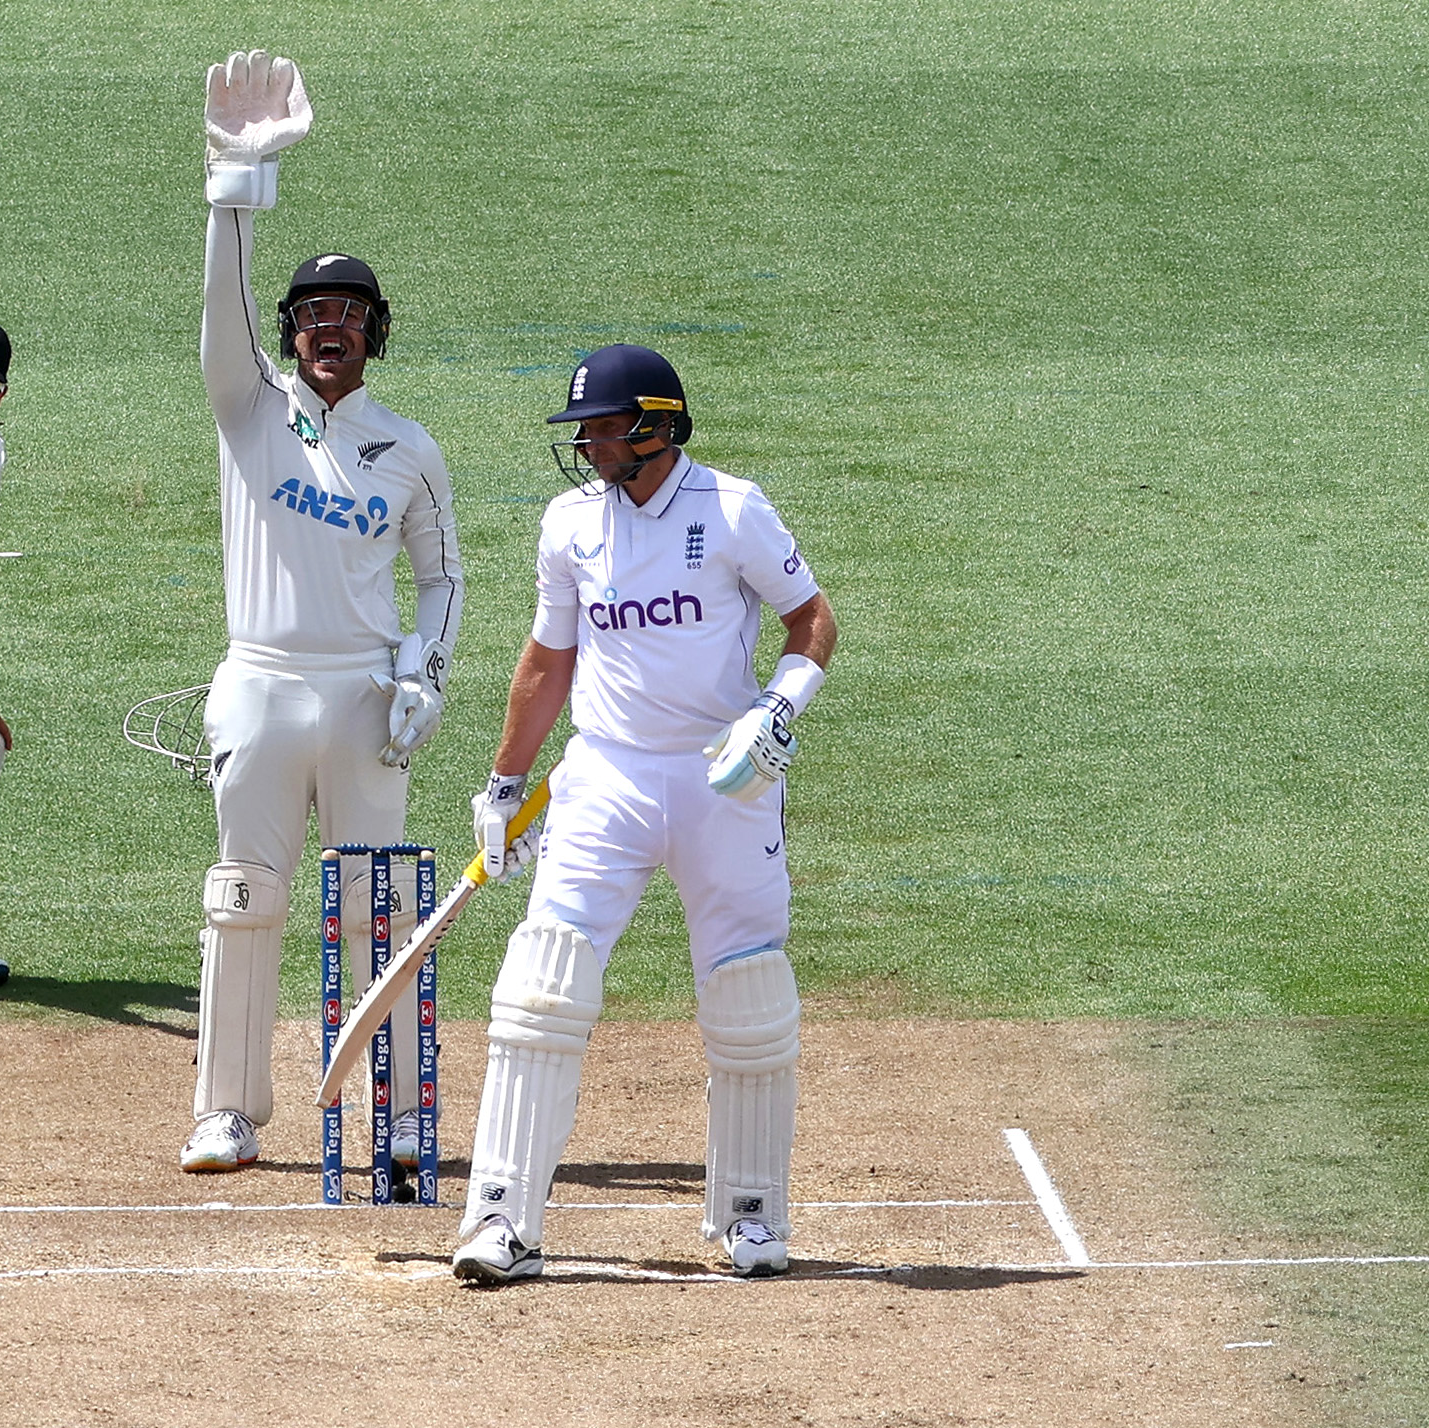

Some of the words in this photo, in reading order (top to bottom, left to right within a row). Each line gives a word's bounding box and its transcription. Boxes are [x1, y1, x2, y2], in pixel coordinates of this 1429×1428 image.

[270, 478, 356, 529] ANZ
[686, 562, 702, 570] 655
[588, 587, 703, 631] cinch
[325, 866, 339, 910] Tegel
[375, 865, 388, 909] Tegel
[419, 866, 434, 910] Tegel
[326, 949, 340, 993] Tegel
[375, 1030, 389, 1073] Tegel
[421, 1032, 435, 1075] Tegel
[325, 1114, 340, 1157] Tegel
[374, 1113, 389, 1155] Tegel
[421, 1114, 435, 1157] Tegel
